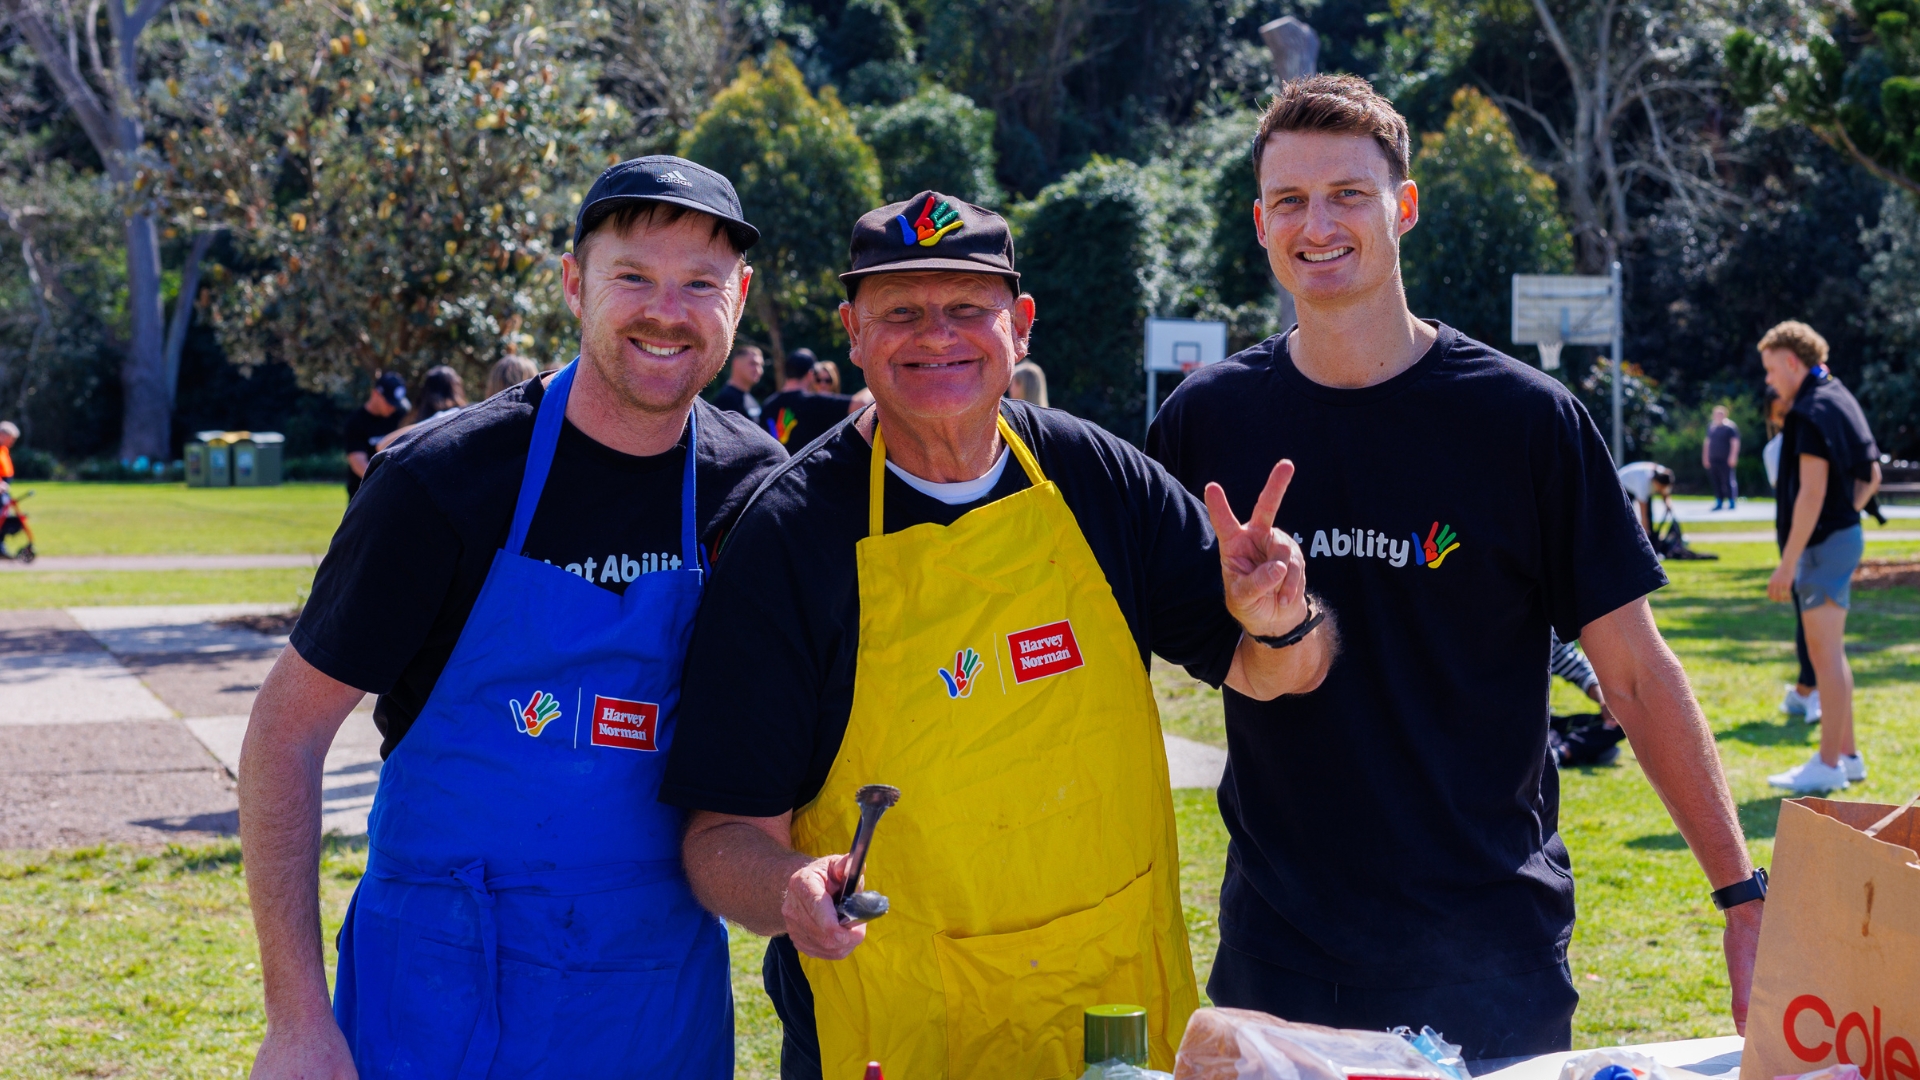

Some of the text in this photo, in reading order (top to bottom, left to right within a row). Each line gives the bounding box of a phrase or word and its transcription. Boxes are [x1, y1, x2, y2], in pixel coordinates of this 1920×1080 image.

[656, 176, 693, 188] adidas
[600, 552, 683, 583] Abilit
[1018, 633, 1063, 655] Harvey
[1019, 648, 1071, 671] Norman
[601, 707, 646, 728] Harvey
[598, 722, 647, 741] Norman
